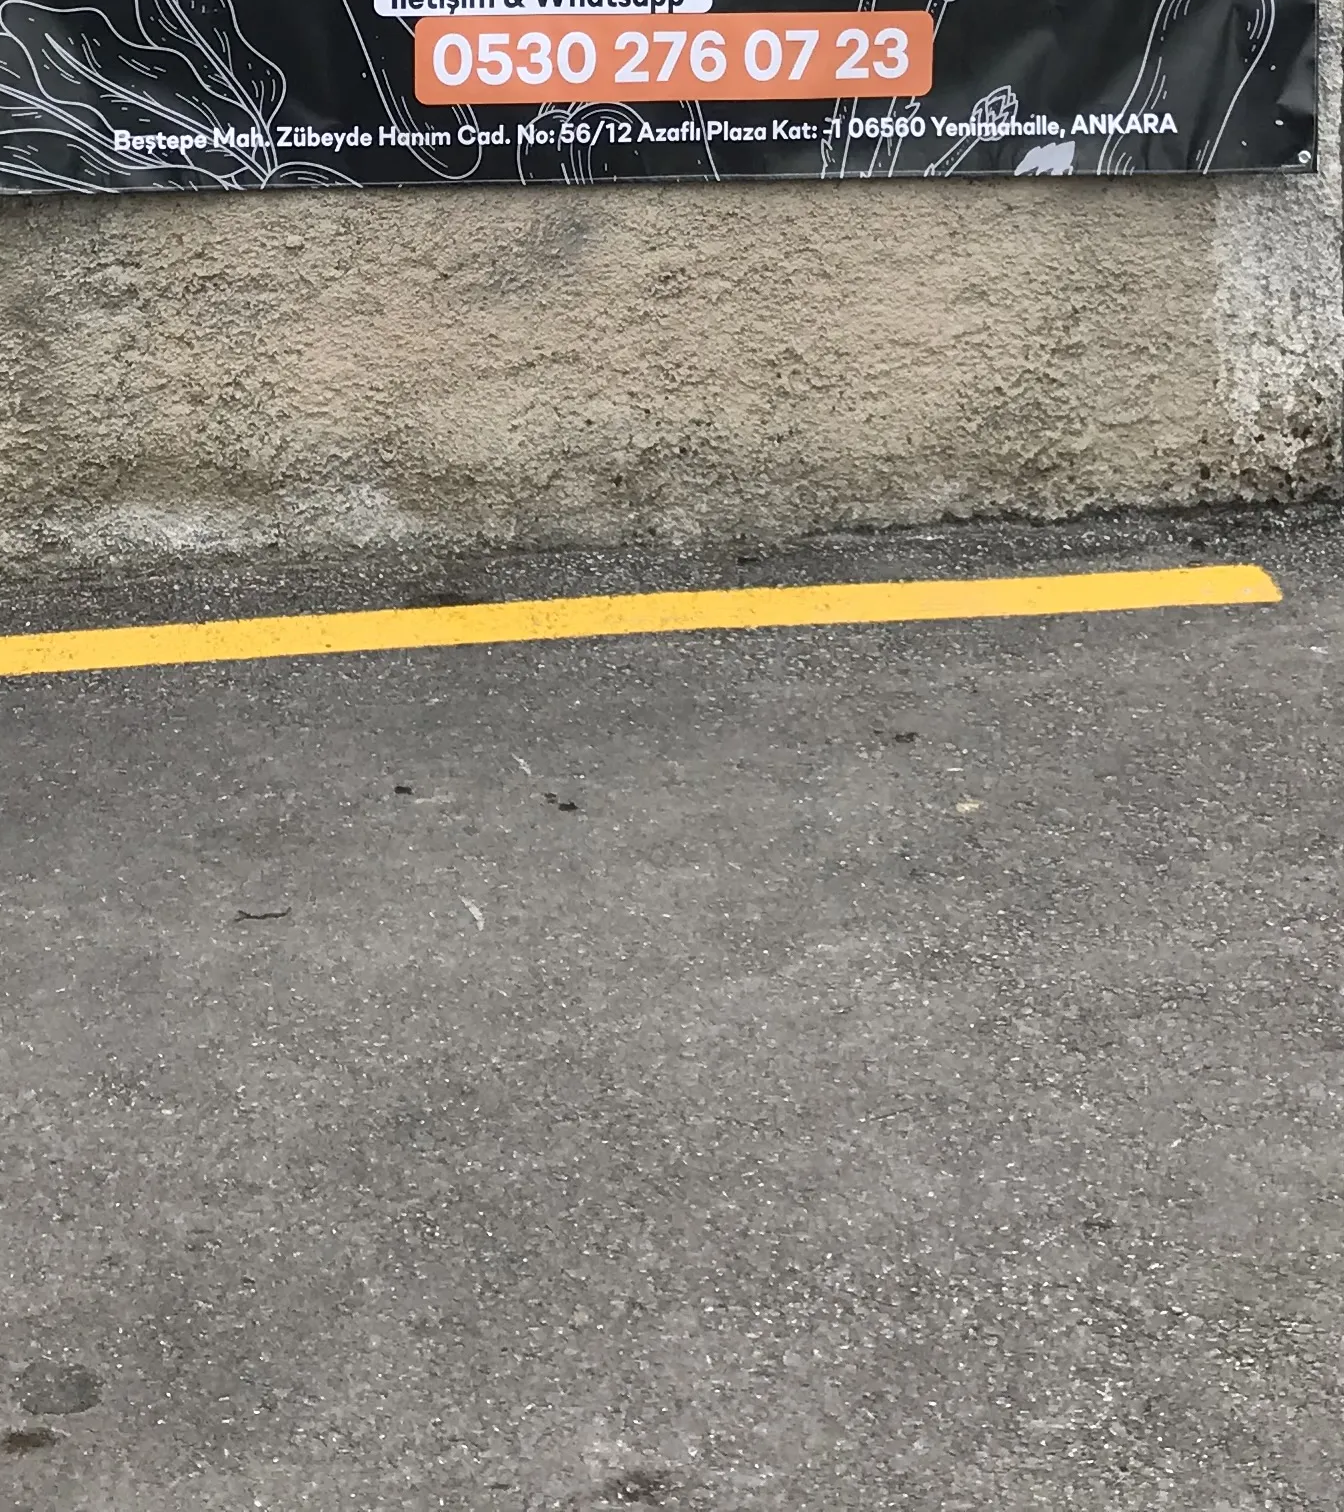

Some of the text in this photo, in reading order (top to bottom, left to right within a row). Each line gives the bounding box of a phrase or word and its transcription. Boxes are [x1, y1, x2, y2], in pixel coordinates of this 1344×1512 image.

[432, 27, 910, 86] 0530 276 07 23
[114, 129, 206, 154] Beştepe
[212, 127, 270, 148] Mah.
[276, 126, 372, 152] Zübeyde
[378, 126, 451, 147] Hanım
[457, 124, 511, 145] Cad.
[517, 124, 555, 145] No:
[560, 120, 632, 146] 56/12
[636, 119, 701, 143] Azaflı
[707, 119, 767, 142] Plaza
[772, 118, 818, 140] Kat:
[848, 116, 926, 138] 06560
[931, 114, 1066, 138] Yenimahalle,
[1071, 112, 1178, 135] ANKARA
